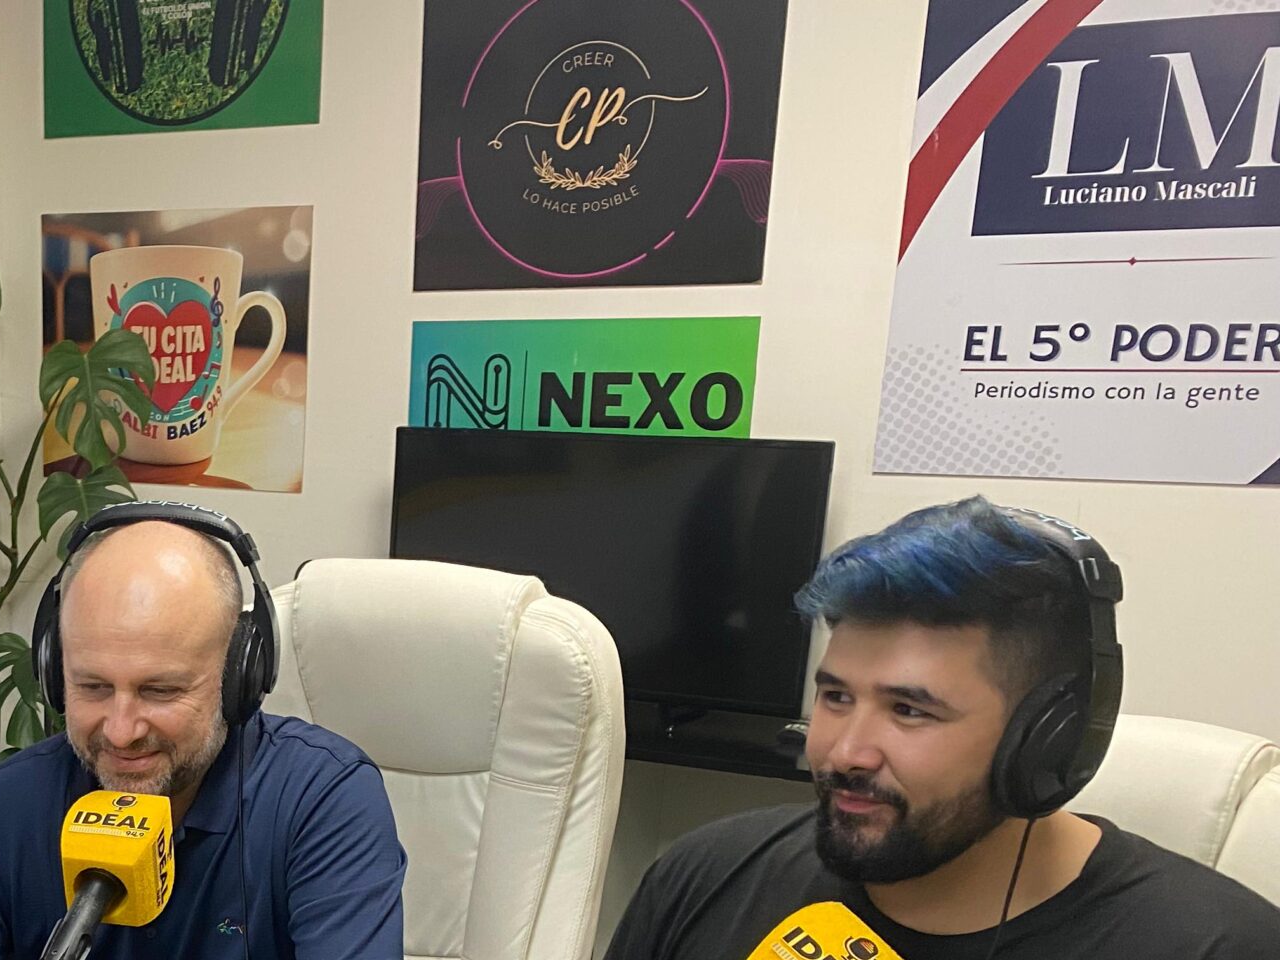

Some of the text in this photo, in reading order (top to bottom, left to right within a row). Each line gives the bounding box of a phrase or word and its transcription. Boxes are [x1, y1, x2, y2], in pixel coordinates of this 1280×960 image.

[562, 51, 615, 73] CREER
[1031, 46, 1280, 180] LM
[522, 184, 640, 214] LO HACE POSIBLE
[1043, 175, 1257, 207] Luciano Mascali
[161, 325, 206, 354] CITA
[963, 325, 1008, 362] EL
[1110, 323, 1280, 362] PODER
[538, 371, 744, 431] NEXO
[974, 380, 1260, 409] Periodismo con la gente
[167, 410, 208, 441] BAEZ
[73, 810, 151, 831] IDEAL
